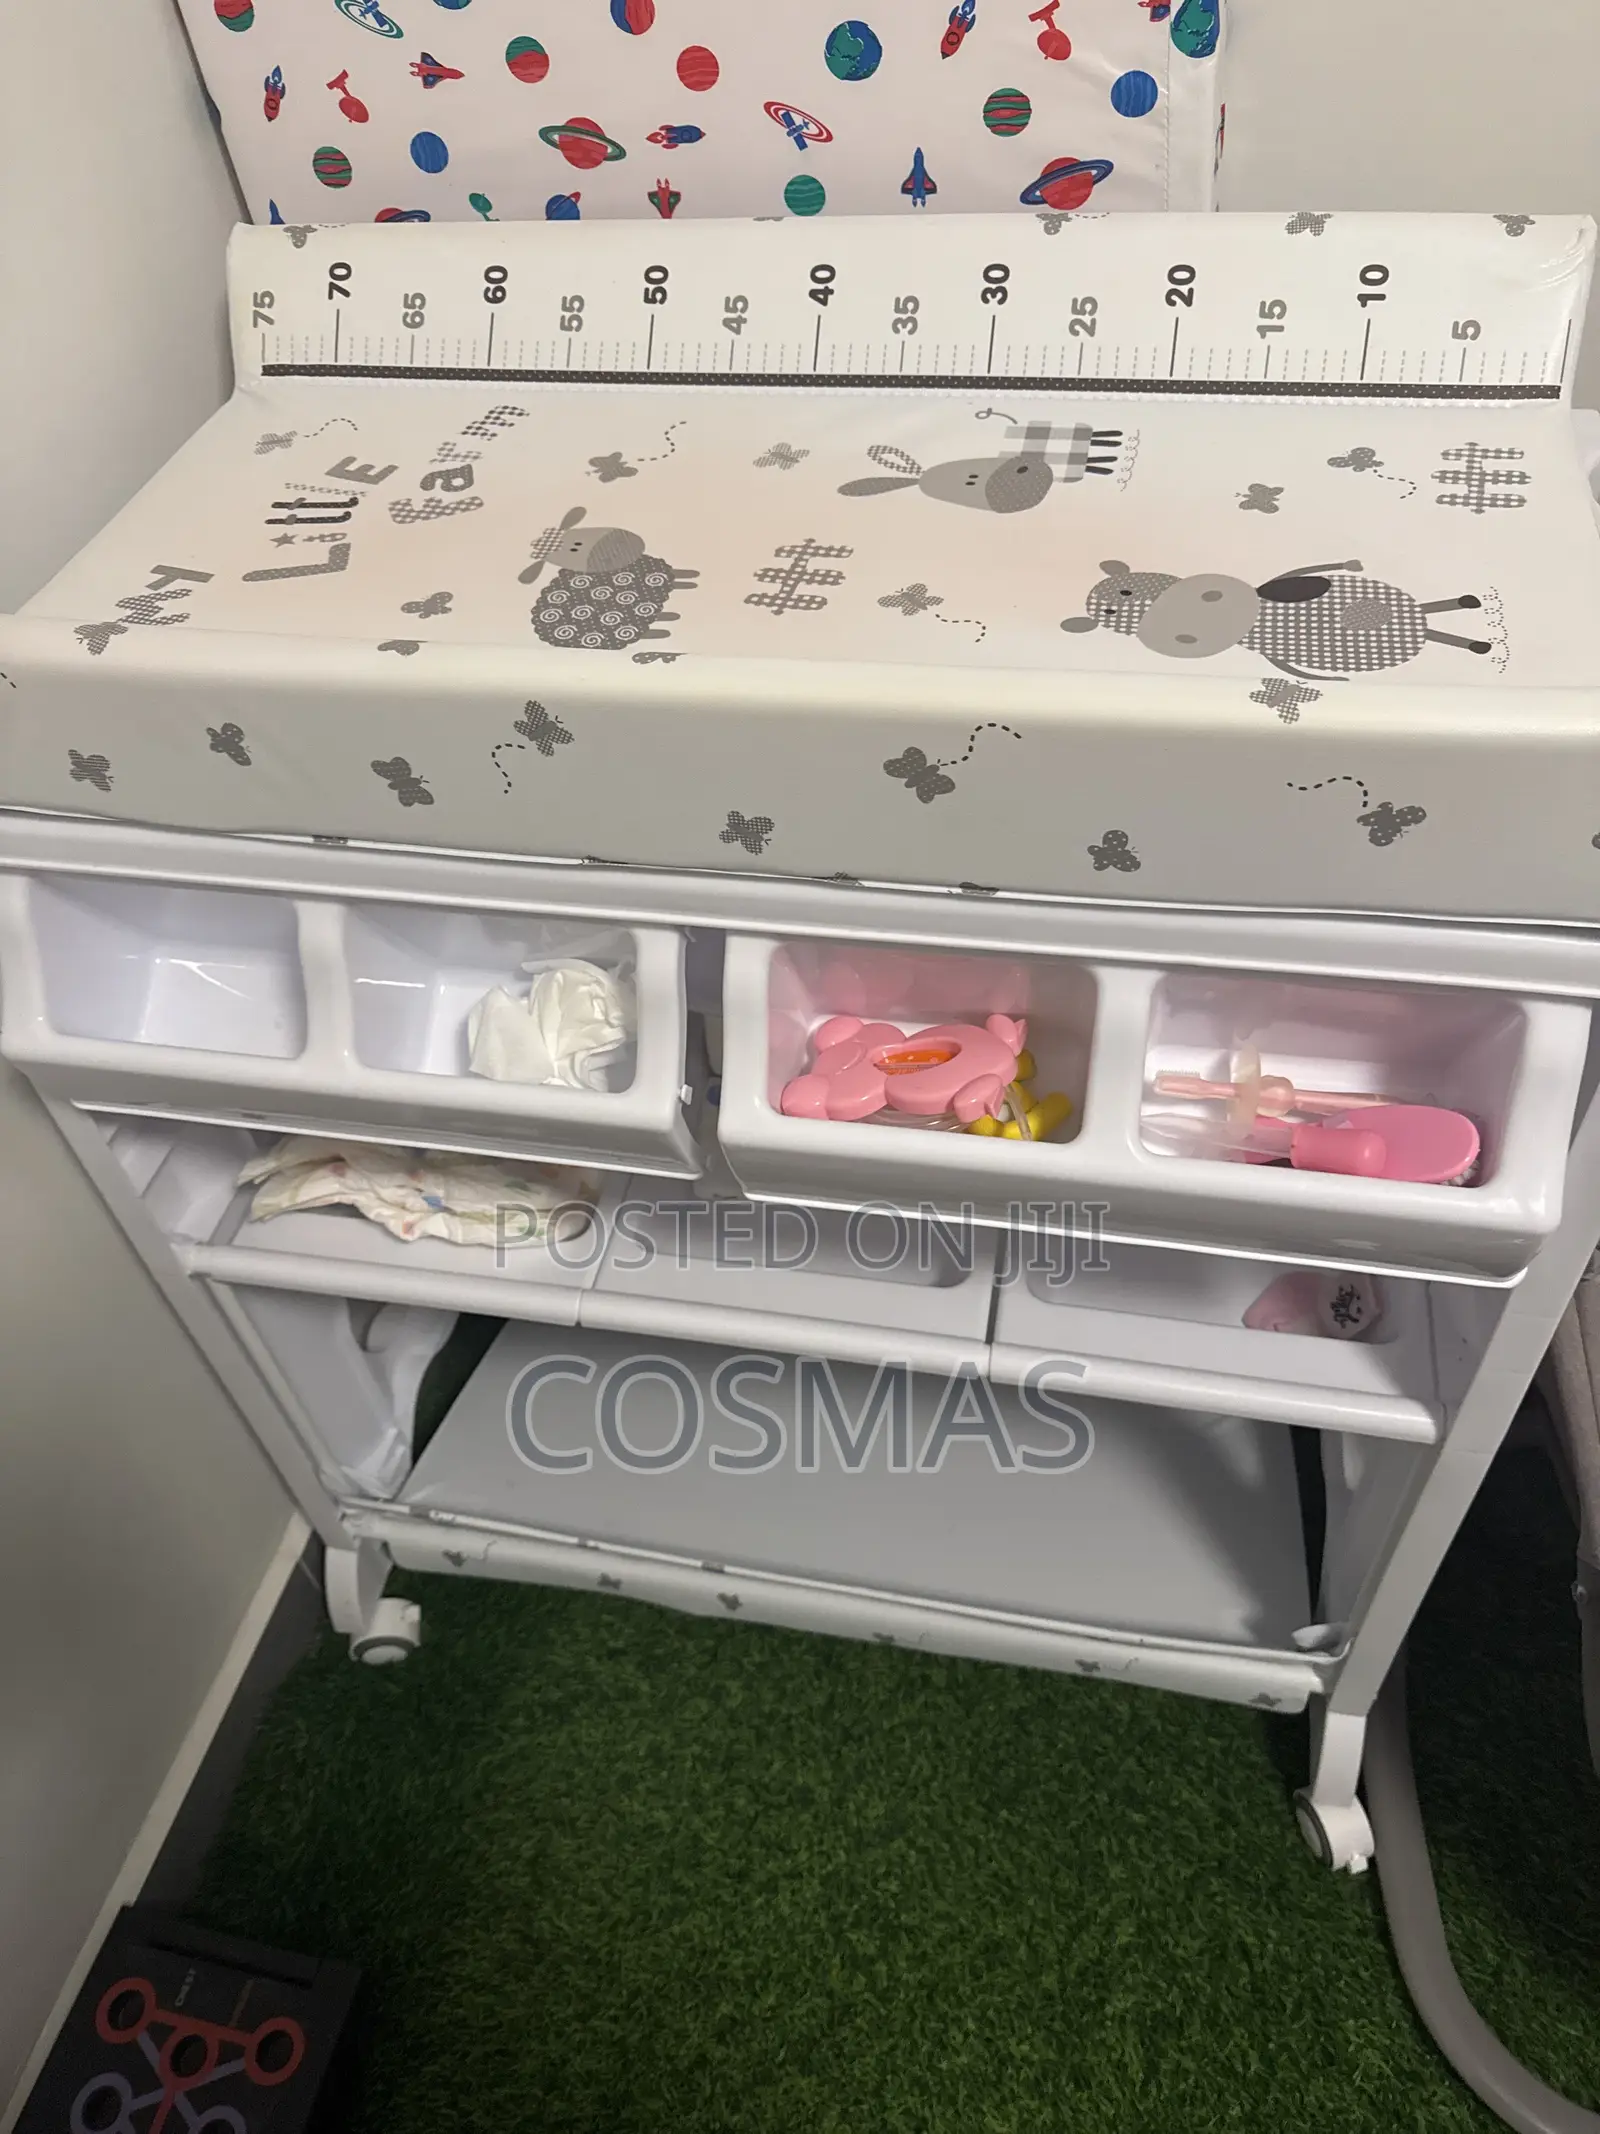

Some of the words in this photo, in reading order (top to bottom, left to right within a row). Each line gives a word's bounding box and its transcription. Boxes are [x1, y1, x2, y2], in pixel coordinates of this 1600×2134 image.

[328, 262, 352, 300] 70
[484, 265, 508, 304] 60
[643, 265, 669, 305] 50
[808, 264, 836, 307] 40
[981, 263, 1010, 305] 30
[1165, 264, 1196, 307] 20
[1357, 264, 1389, 308] 10
[253, 291, 274, 328] 75
[402, 293, 426, 329] 65
[560, 295, 584, 332] 55
[722, 295, 748, 335] 45
[892, 296, 919, 335] 35
[1069, 297, 1098, 337] 25
[1256, 300, 1287, 339] 15
[1452, 320, 1481, 340] 5
